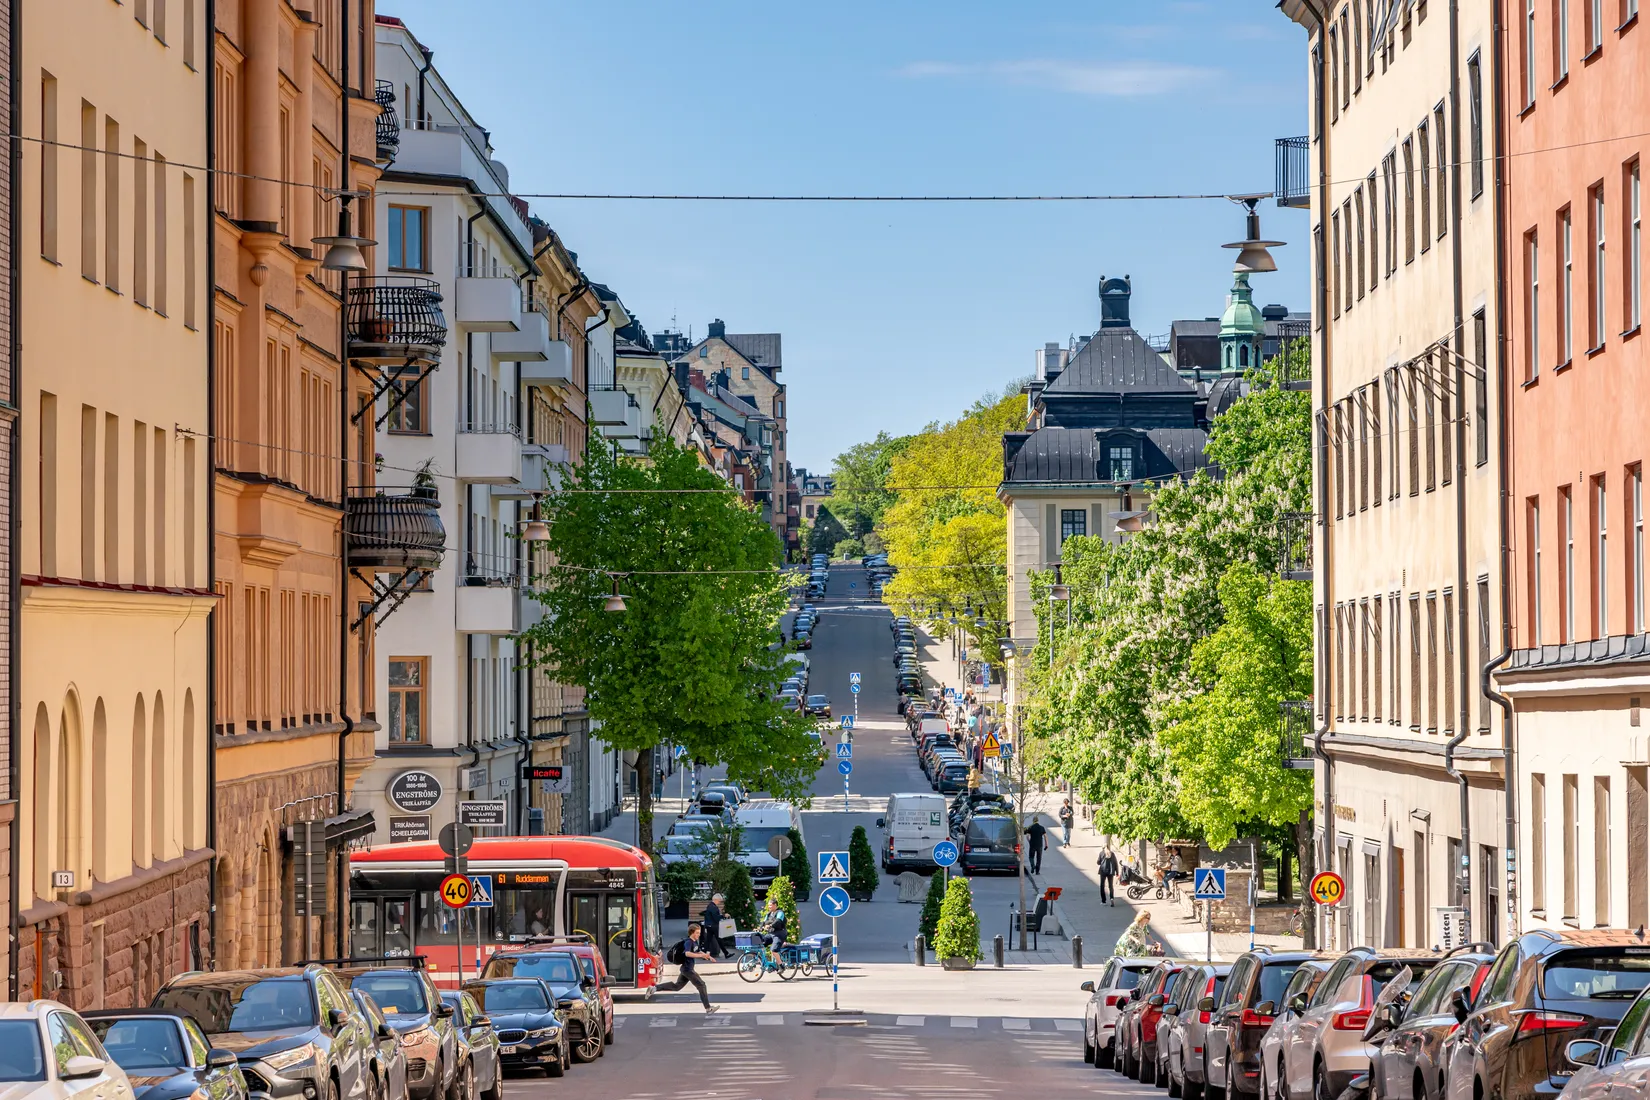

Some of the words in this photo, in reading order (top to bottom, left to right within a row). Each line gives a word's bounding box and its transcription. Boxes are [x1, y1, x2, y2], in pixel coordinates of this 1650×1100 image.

[396, 790, 438, 799] ENGSTRÖMS
[462, 804, 504, 812] ENGSTRÖMS
[59, 874, 69, 885] 13
[498, 874, 506, 883] 61
[515, 875, 549, 883] Ruddammen
[445, 883, 468, 900] 40
[1316, 880, 1340, 897] 40
